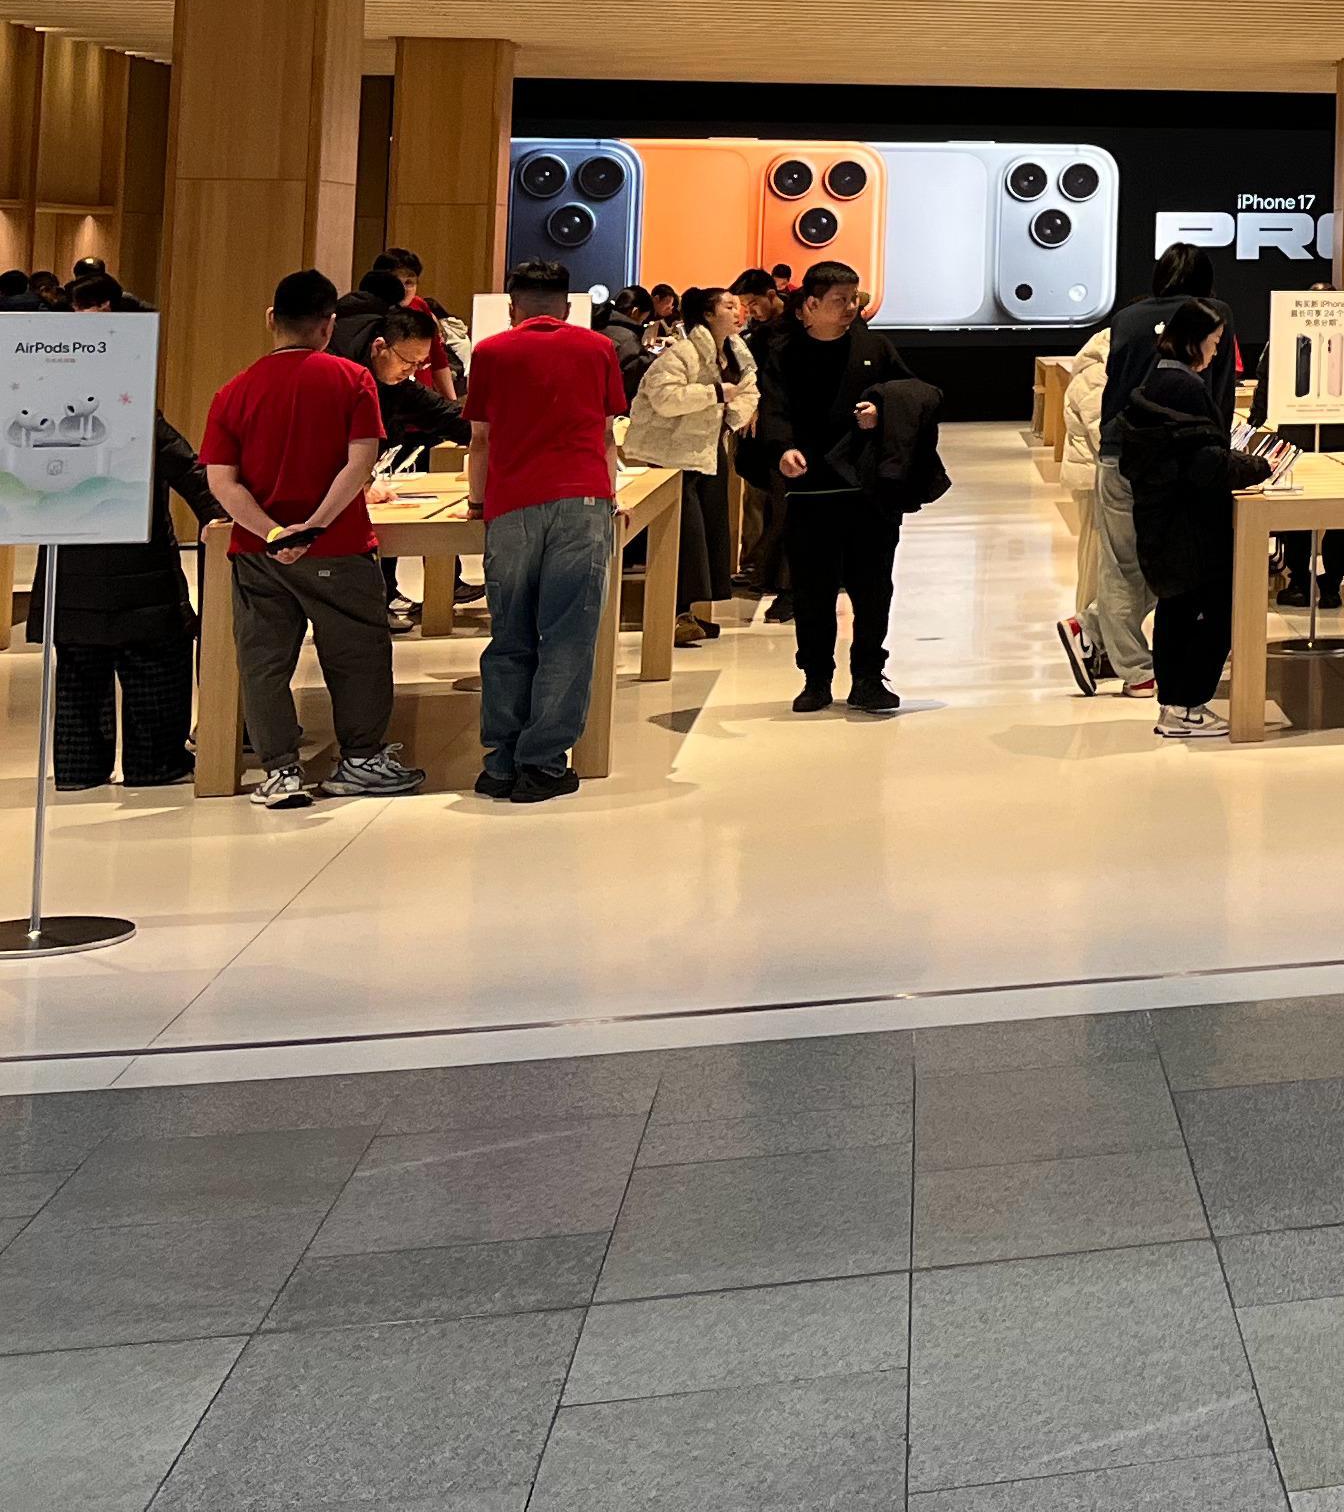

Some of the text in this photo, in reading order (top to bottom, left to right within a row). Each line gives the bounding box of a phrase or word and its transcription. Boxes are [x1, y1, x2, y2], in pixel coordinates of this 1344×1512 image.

[1237, 194, 1316, 210] iPhone 17
[1155, 212, 1334, 260] PR
[15, 342, 107, 354] AirPods Pro 3
